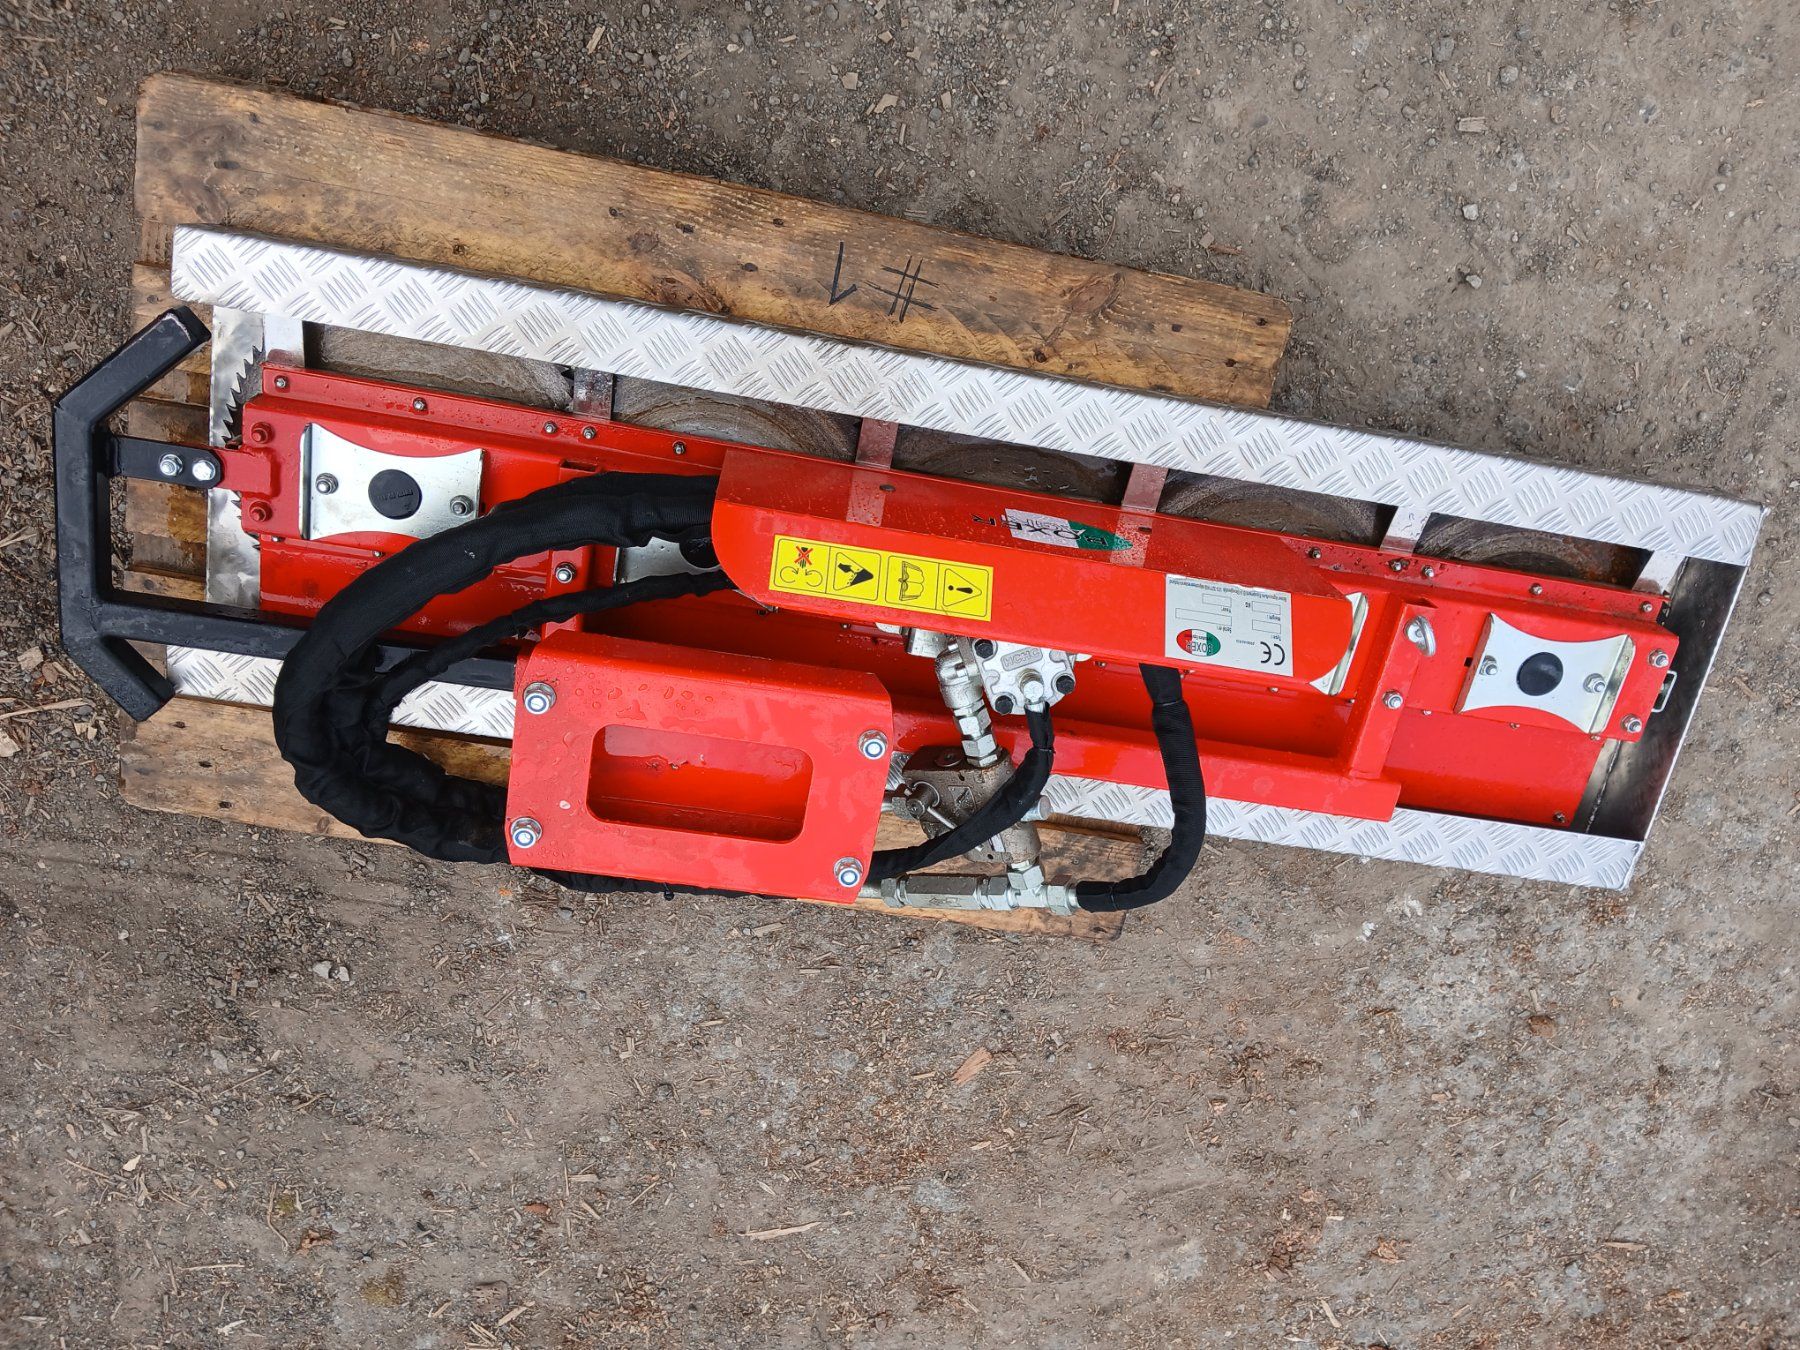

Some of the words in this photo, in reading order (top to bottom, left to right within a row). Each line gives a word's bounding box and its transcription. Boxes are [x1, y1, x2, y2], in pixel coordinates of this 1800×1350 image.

[971, 513, 1109, 546] BOXER
[1186, 640, 1214, 654] BOXER
[1260, 641, 1285, 666] CE
